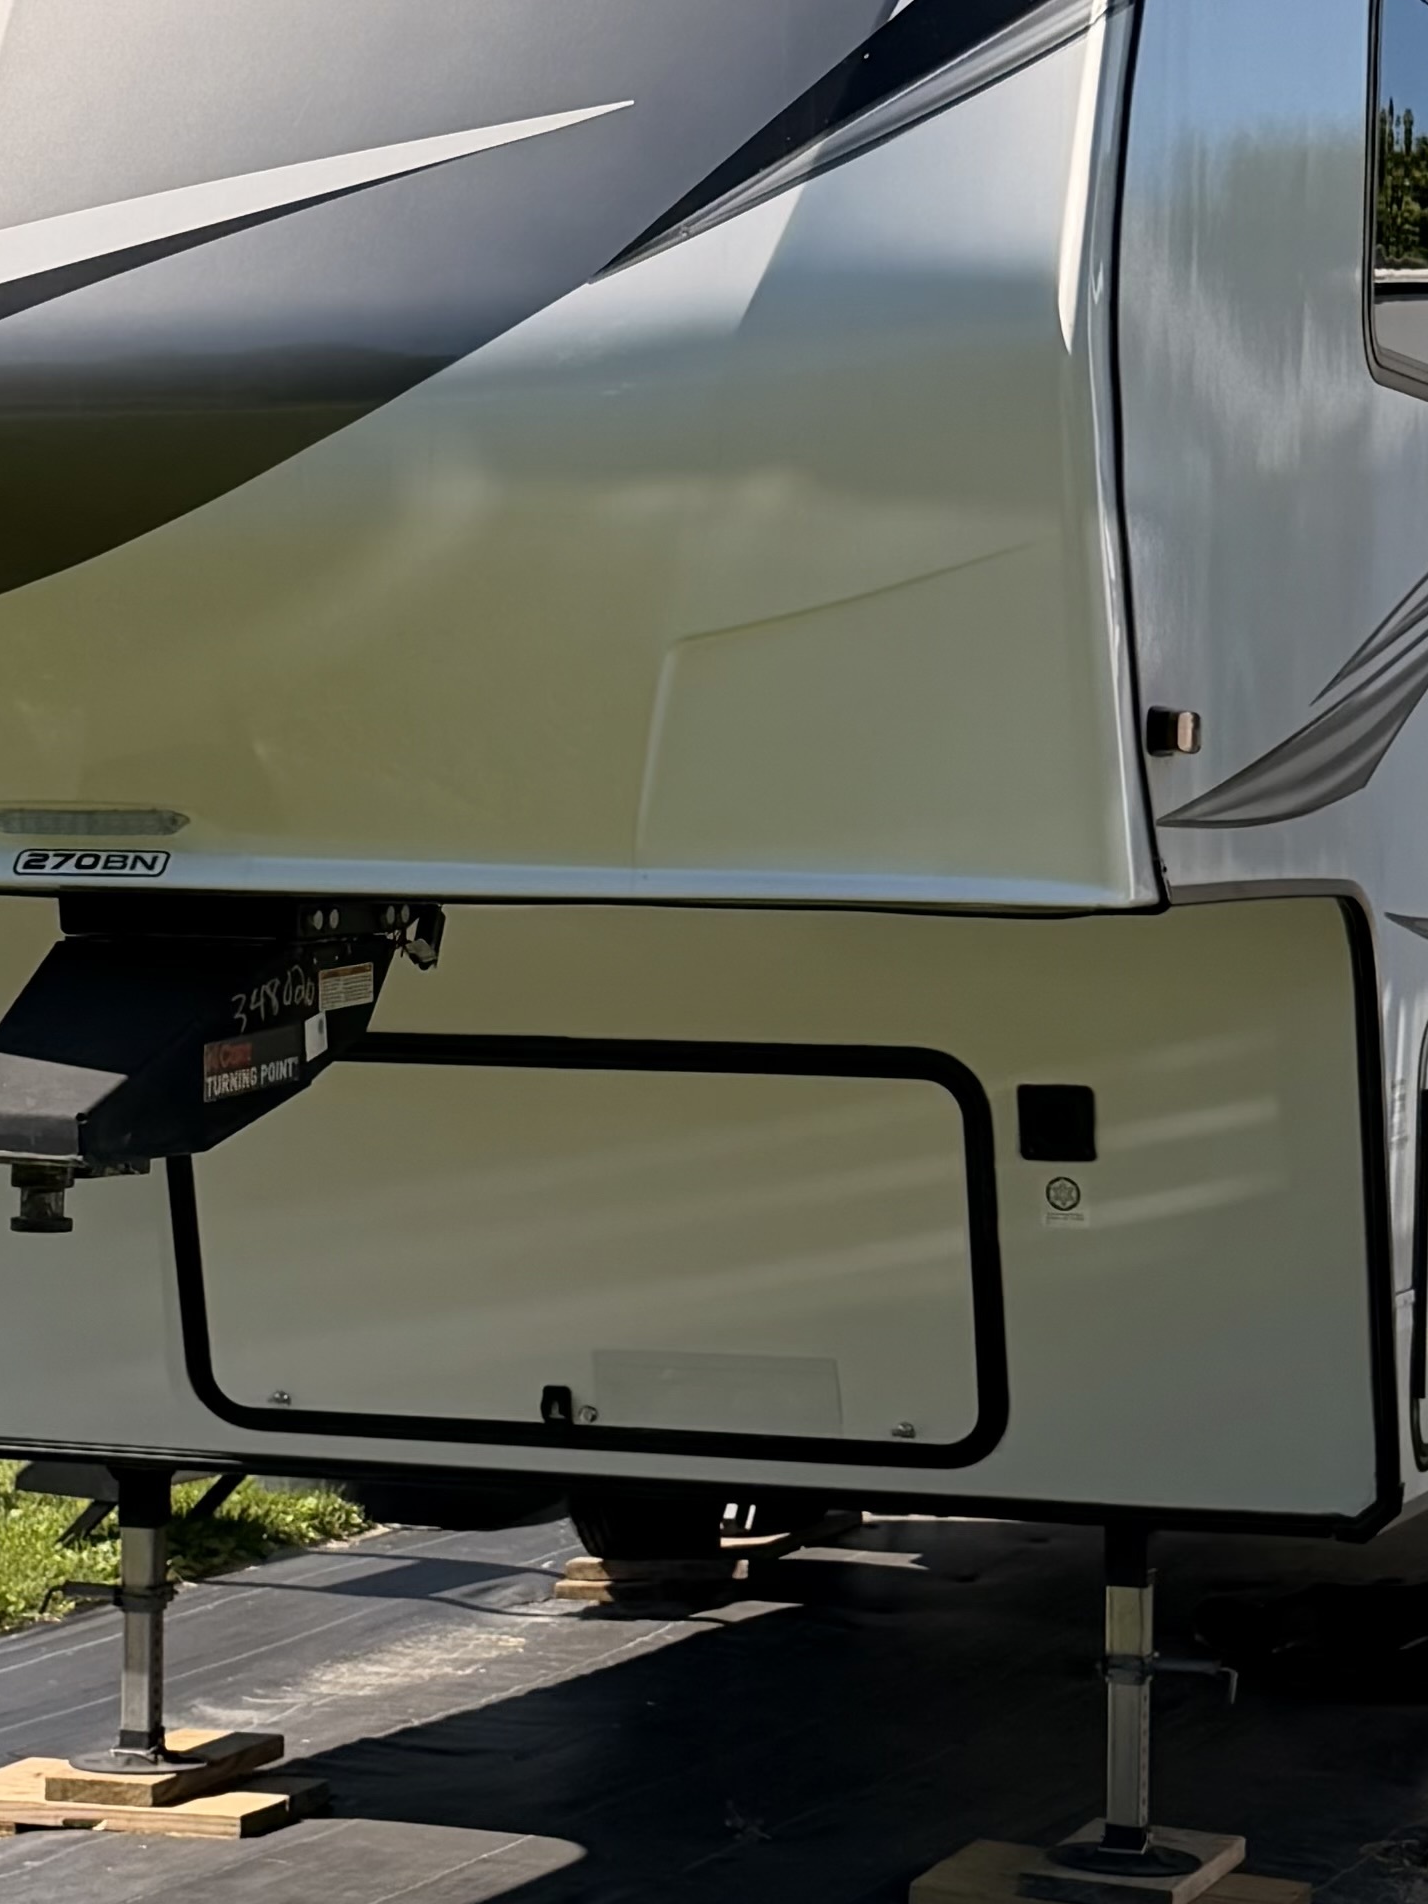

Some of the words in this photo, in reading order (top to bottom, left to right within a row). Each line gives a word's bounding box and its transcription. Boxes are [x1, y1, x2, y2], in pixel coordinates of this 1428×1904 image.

[22, 851, 159, 872] 270BN
[206, 1065, 258, 1098] TURNING
[260, 1056, 297, 1086] POINT
